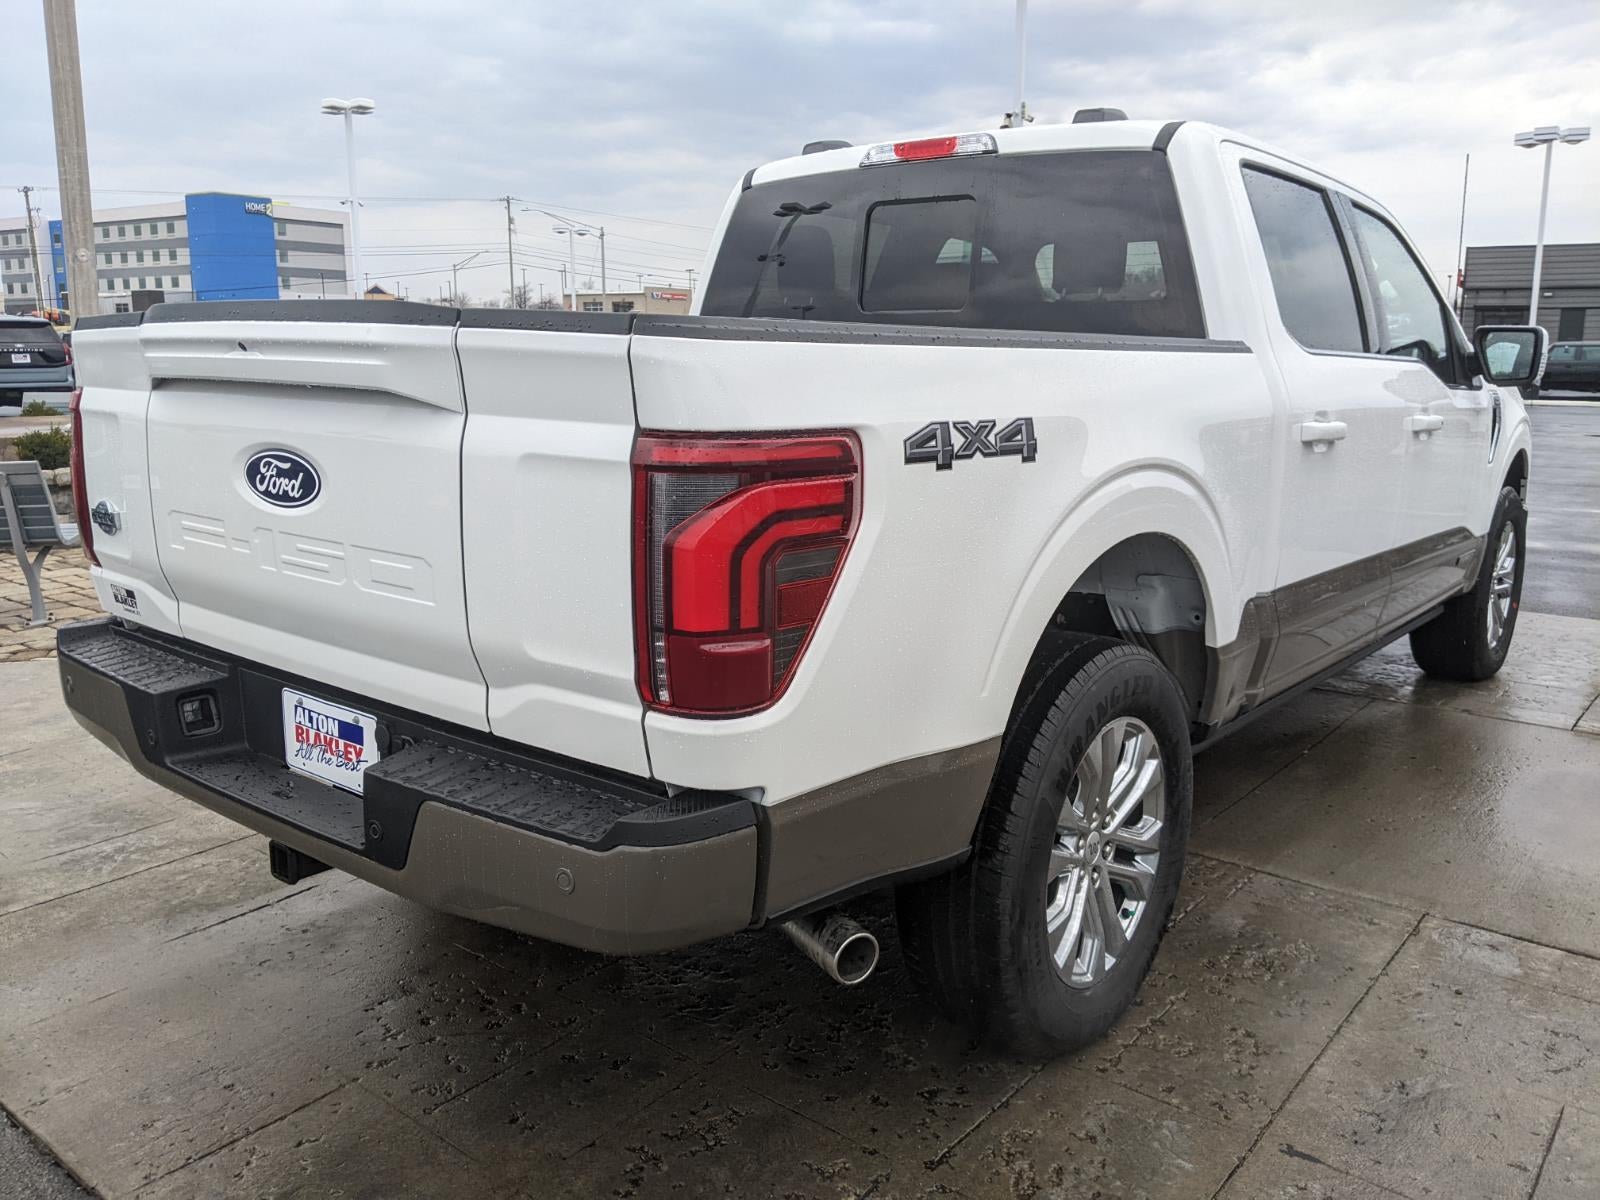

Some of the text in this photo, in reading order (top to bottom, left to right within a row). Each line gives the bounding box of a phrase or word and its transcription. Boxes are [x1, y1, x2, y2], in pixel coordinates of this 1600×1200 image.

[256, 457, 304, 498] Ford
[168, 509, 436, 606] F-150
[295, 706, 339, 738] ALTON
[295, 724, 364, 763] BLAKLEY
[295, 741, 368, 772] All The Best
